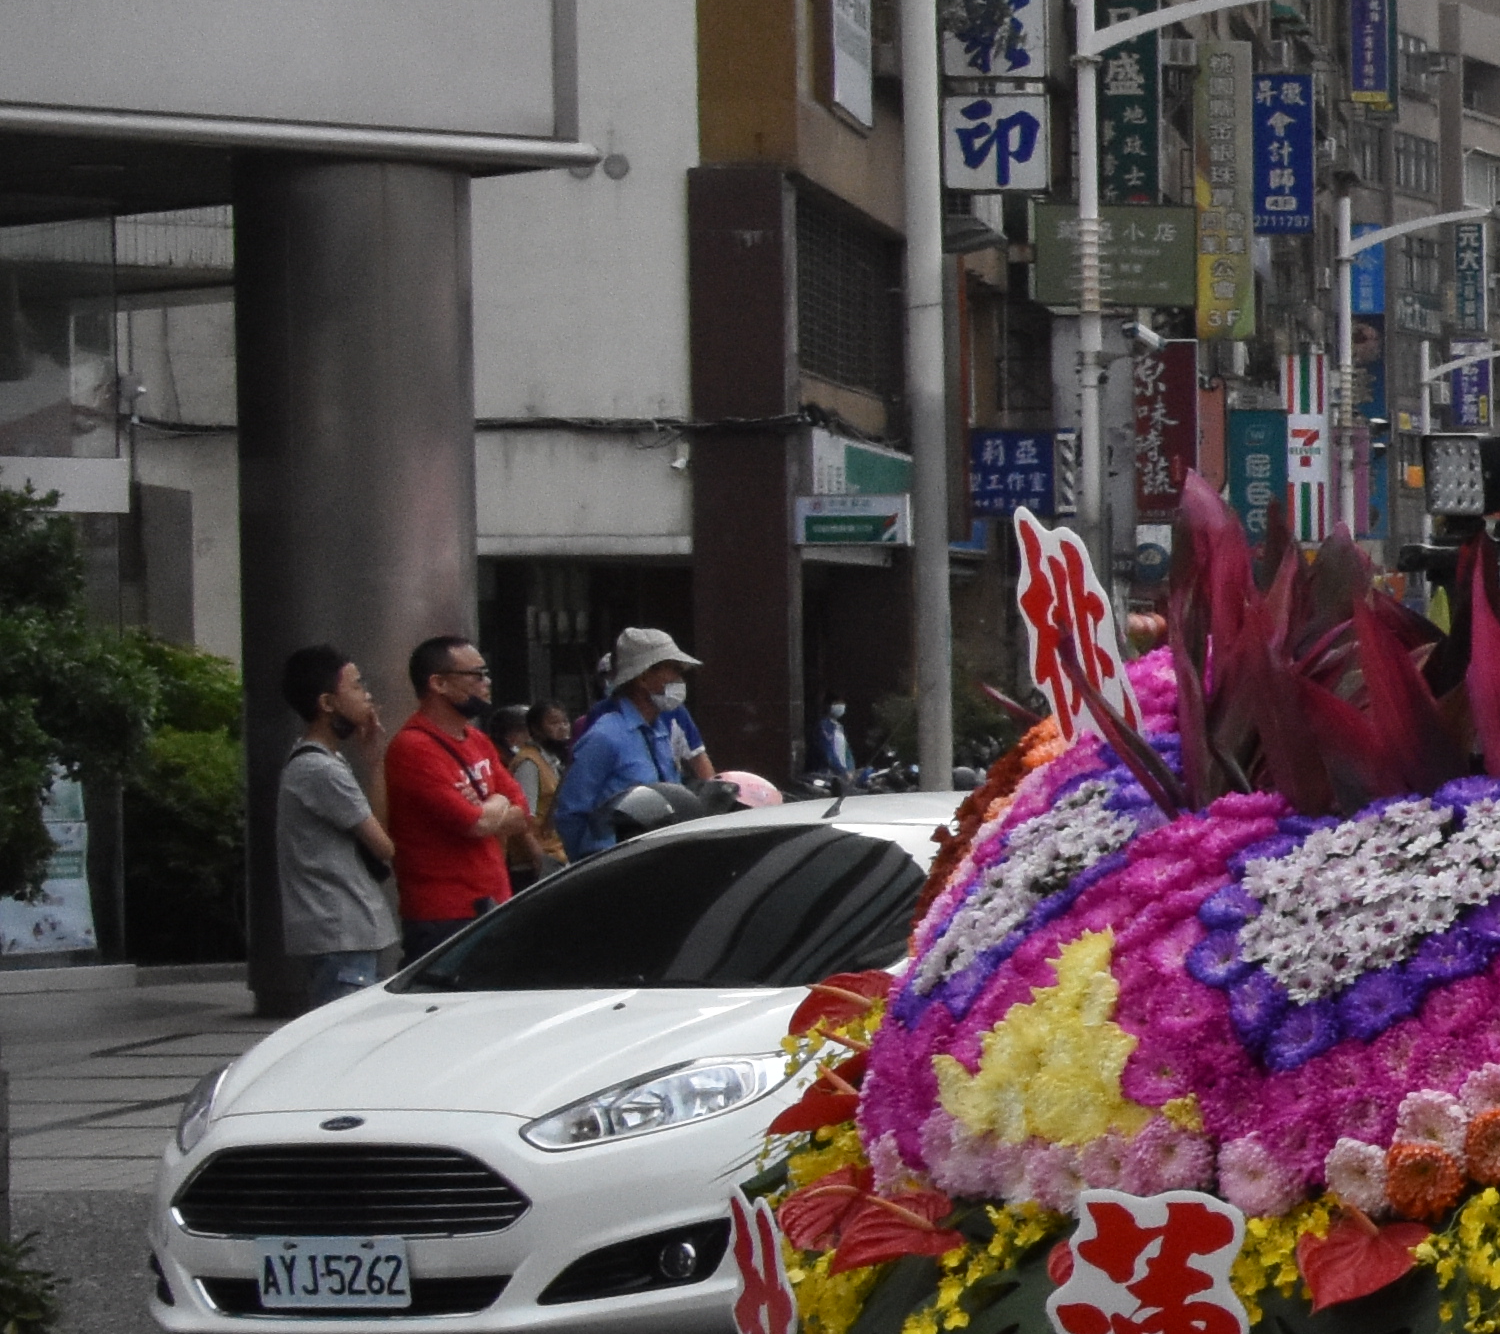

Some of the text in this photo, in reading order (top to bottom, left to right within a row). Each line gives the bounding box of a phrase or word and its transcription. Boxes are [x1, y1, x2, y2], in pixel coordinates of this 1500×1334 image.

[1122, 104, 1148, 187] 地政士
[1267, 111, 1297, 195] 會計師
[1206, 308, 1242, 327] 3F
[970, 438, 1040, 468] 莉亞
[1020, 520, 1138, 744] 桃
[263, 1254, 407, 1296] AYJ-5262
